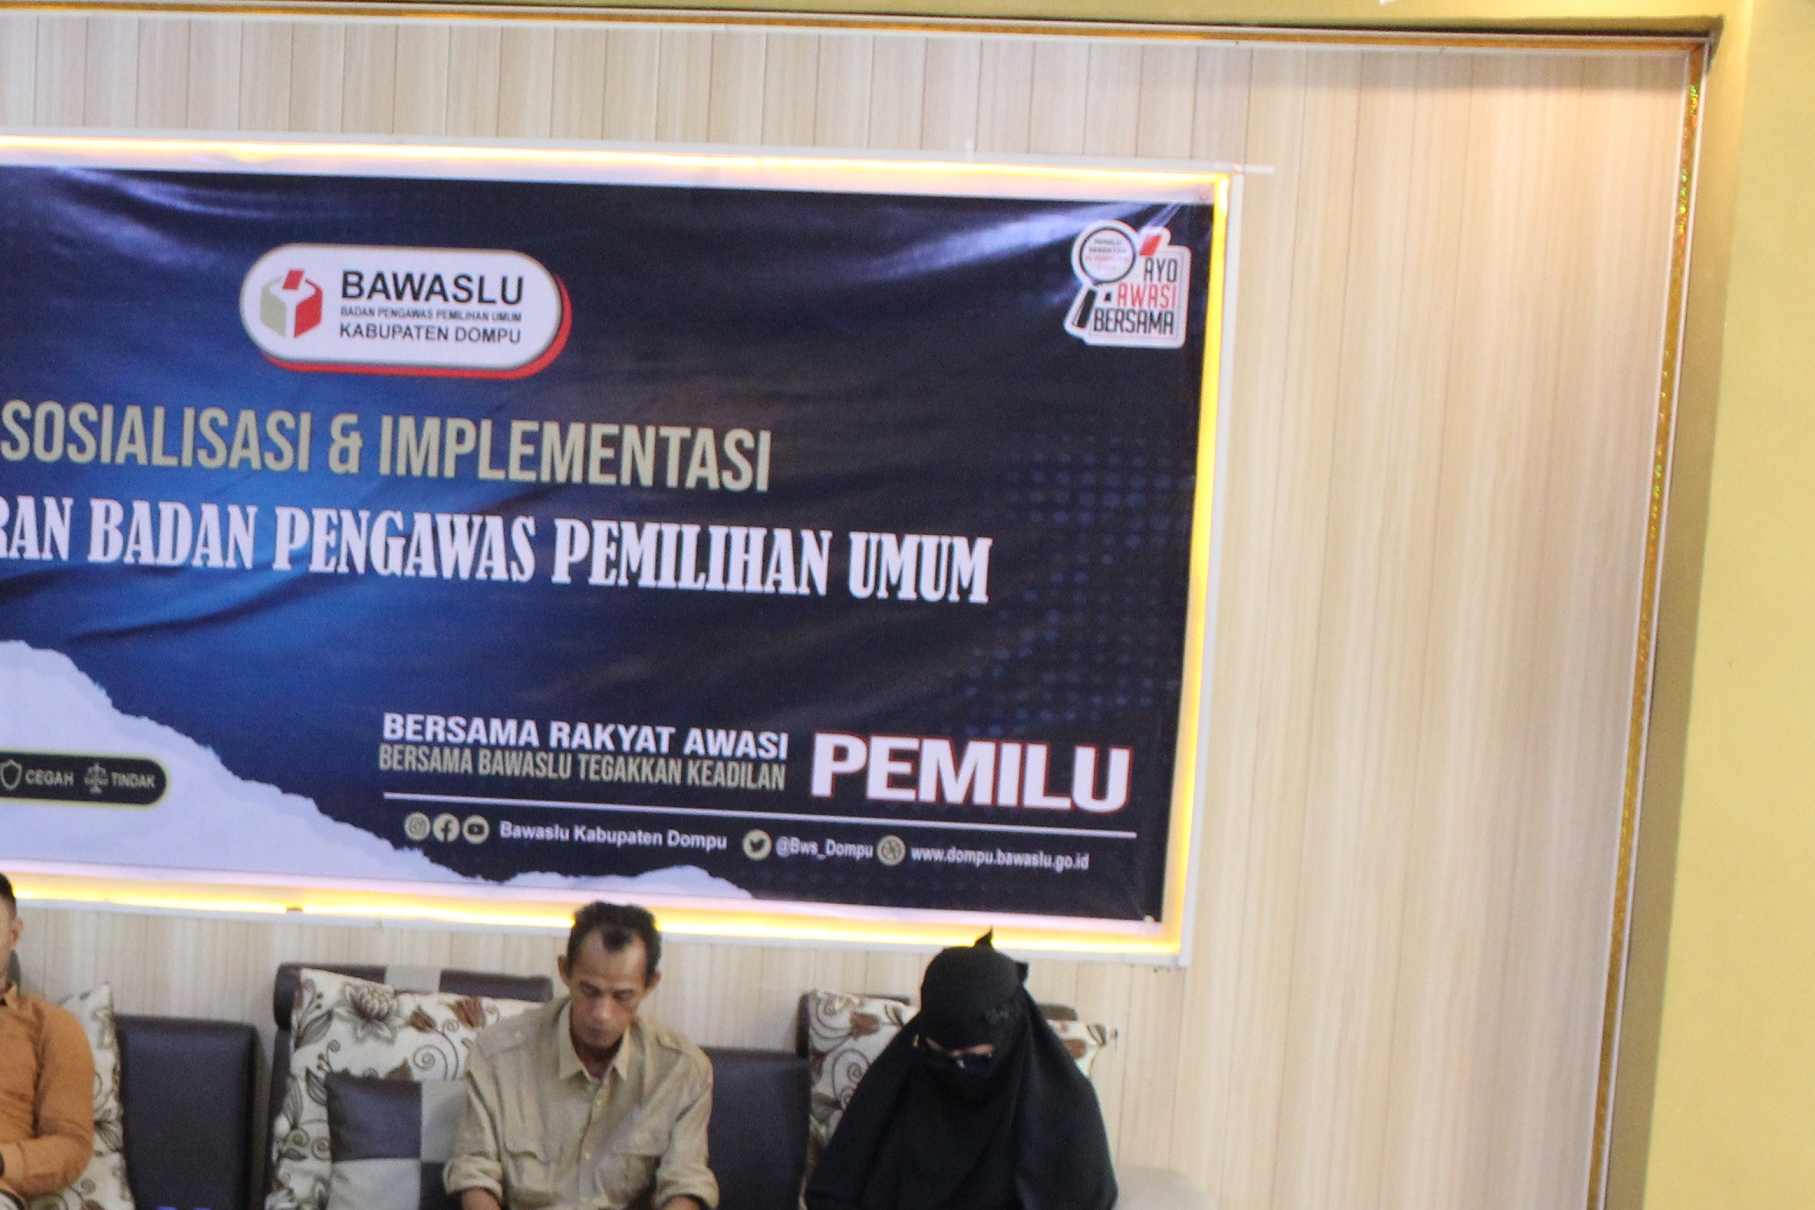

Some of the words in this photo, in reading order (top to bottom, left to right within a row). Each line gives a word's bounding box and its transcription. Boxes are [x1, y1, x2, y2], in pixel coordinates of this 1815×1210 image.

[1144, 257, 1178, 282] AYO
[341, 270, 523, 305] BAWASLU
[1117, 282, 1176, 309] AWASI
[340, 306, 376, 317] BADAN
[378, 307, 433, 319] PENGAWAS
[436, 309, 489, 321] PEMILIHAN
[1093, 308, 1174, 335] BERSAMA
[340, 323, 449, 342] KABUPATEN
[455, 326, 521, 344] DOMPU
[0, 400, 311, 473] SOSIALISASI
[329, 413, 363, 475] &
[379, 415, 772, 493] IMPLEMENTASI
[88, 496, 258, 571] BADAN
[272, 506, 536, 584] PENGAWAS
[551, 518, 833, 598] PEMILIHAN
[848, 531, 992, 603] UMUM
[383, 712, 540, 748] BERSAMA
[549, 720, 676, 755] RAKYAT
[683, 728, 788, 760] AWASI
[25, 769, 74, 786] CEGAH
[111, 772, 156, 788] TINDAK
[379, 743, 473, 774] BERSAMA
[479, 748, 572, 780] BAWASLU
[578, 754, 682, 786] TEGAKKAN
[687, 759, 787, 792] KEADILAN
[811, 731, 1133, 813] PEMILU
[499, 820, 569, 842] Bawaslu
[574, 824, 663, 847] Kabupaten
[667, 830, 727, 852] Dompu
[776, 837, 873, 860] @Bws_Dompu
[910, 844, 1090, 872] www.dompu.bawaslu.go.id
